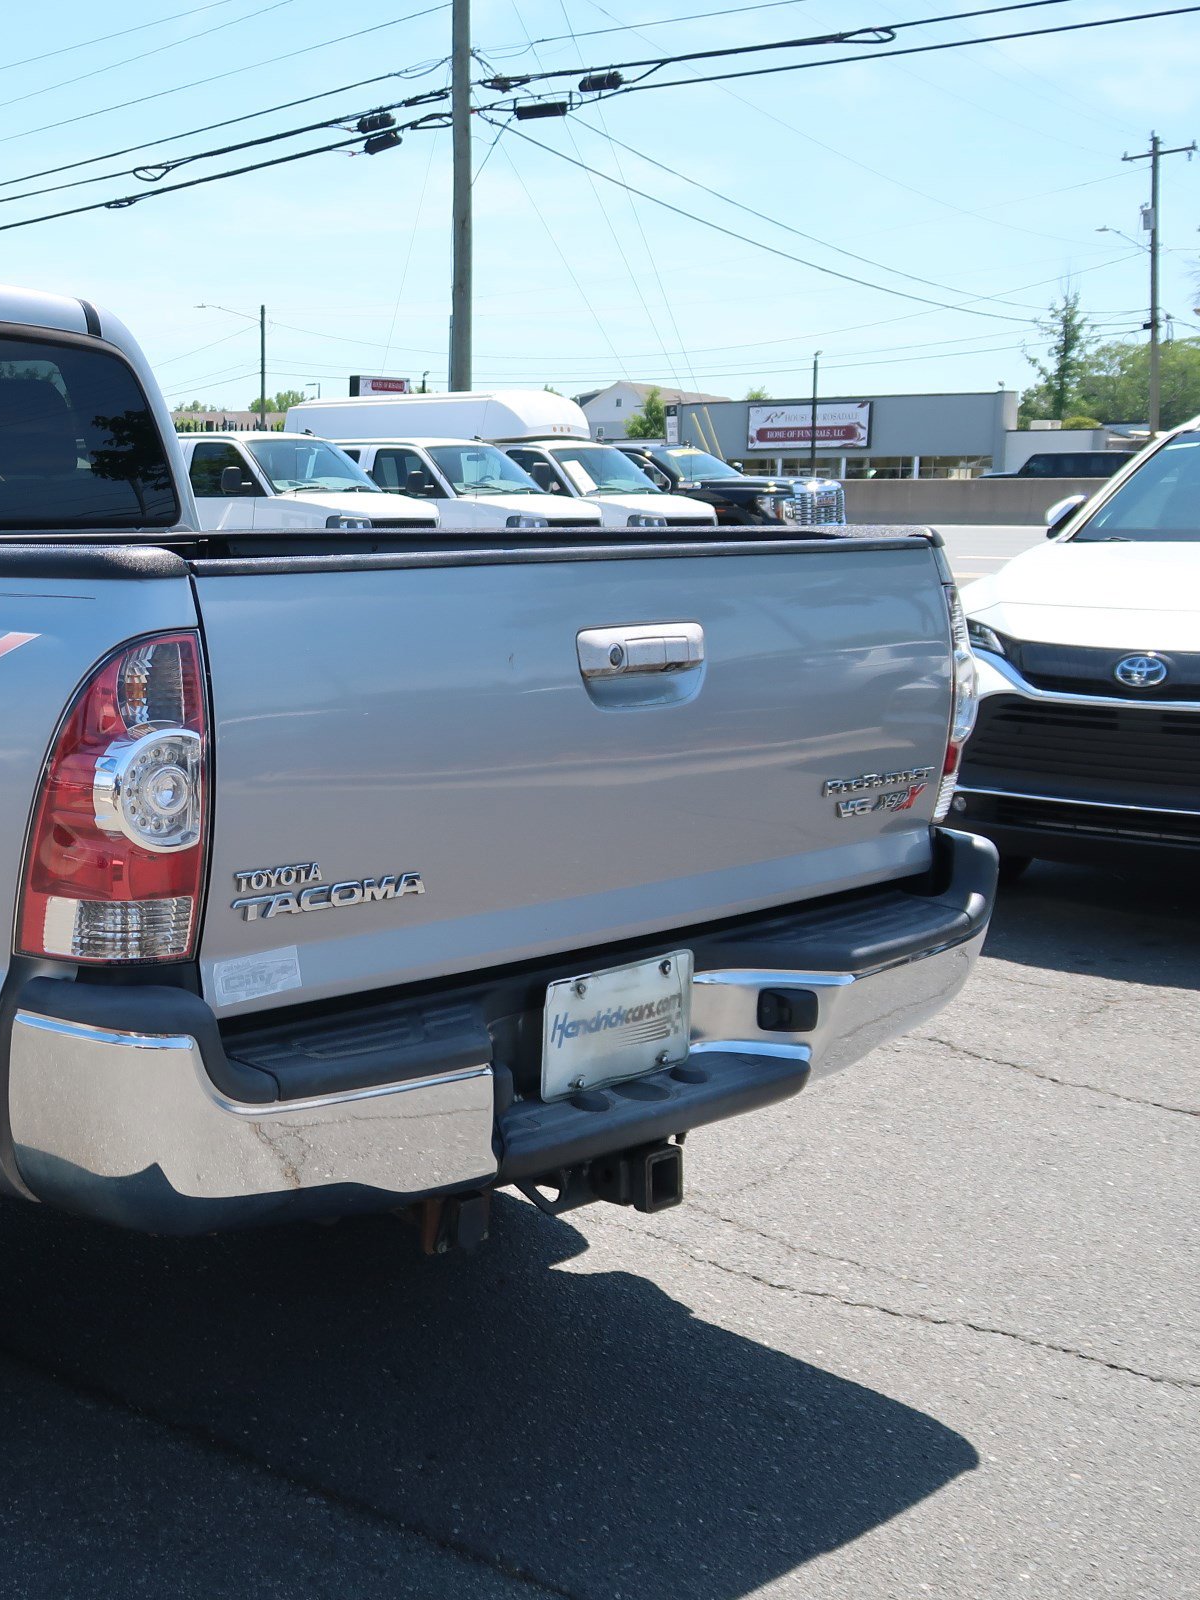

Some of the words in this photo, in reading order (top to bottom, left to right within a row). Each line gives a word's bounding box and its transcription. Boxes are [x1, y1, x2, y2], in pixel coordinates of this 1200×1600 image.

[767, 430, 786, 438] HOME
[787, 430, 797, 438] OF
[797, 429, 833, 438] FUNRALS,
[834, 428, 846, 437] LLC
[235, 862, 322, 893] TOYOTA
[231, 872, 426, 922] TACOMA
